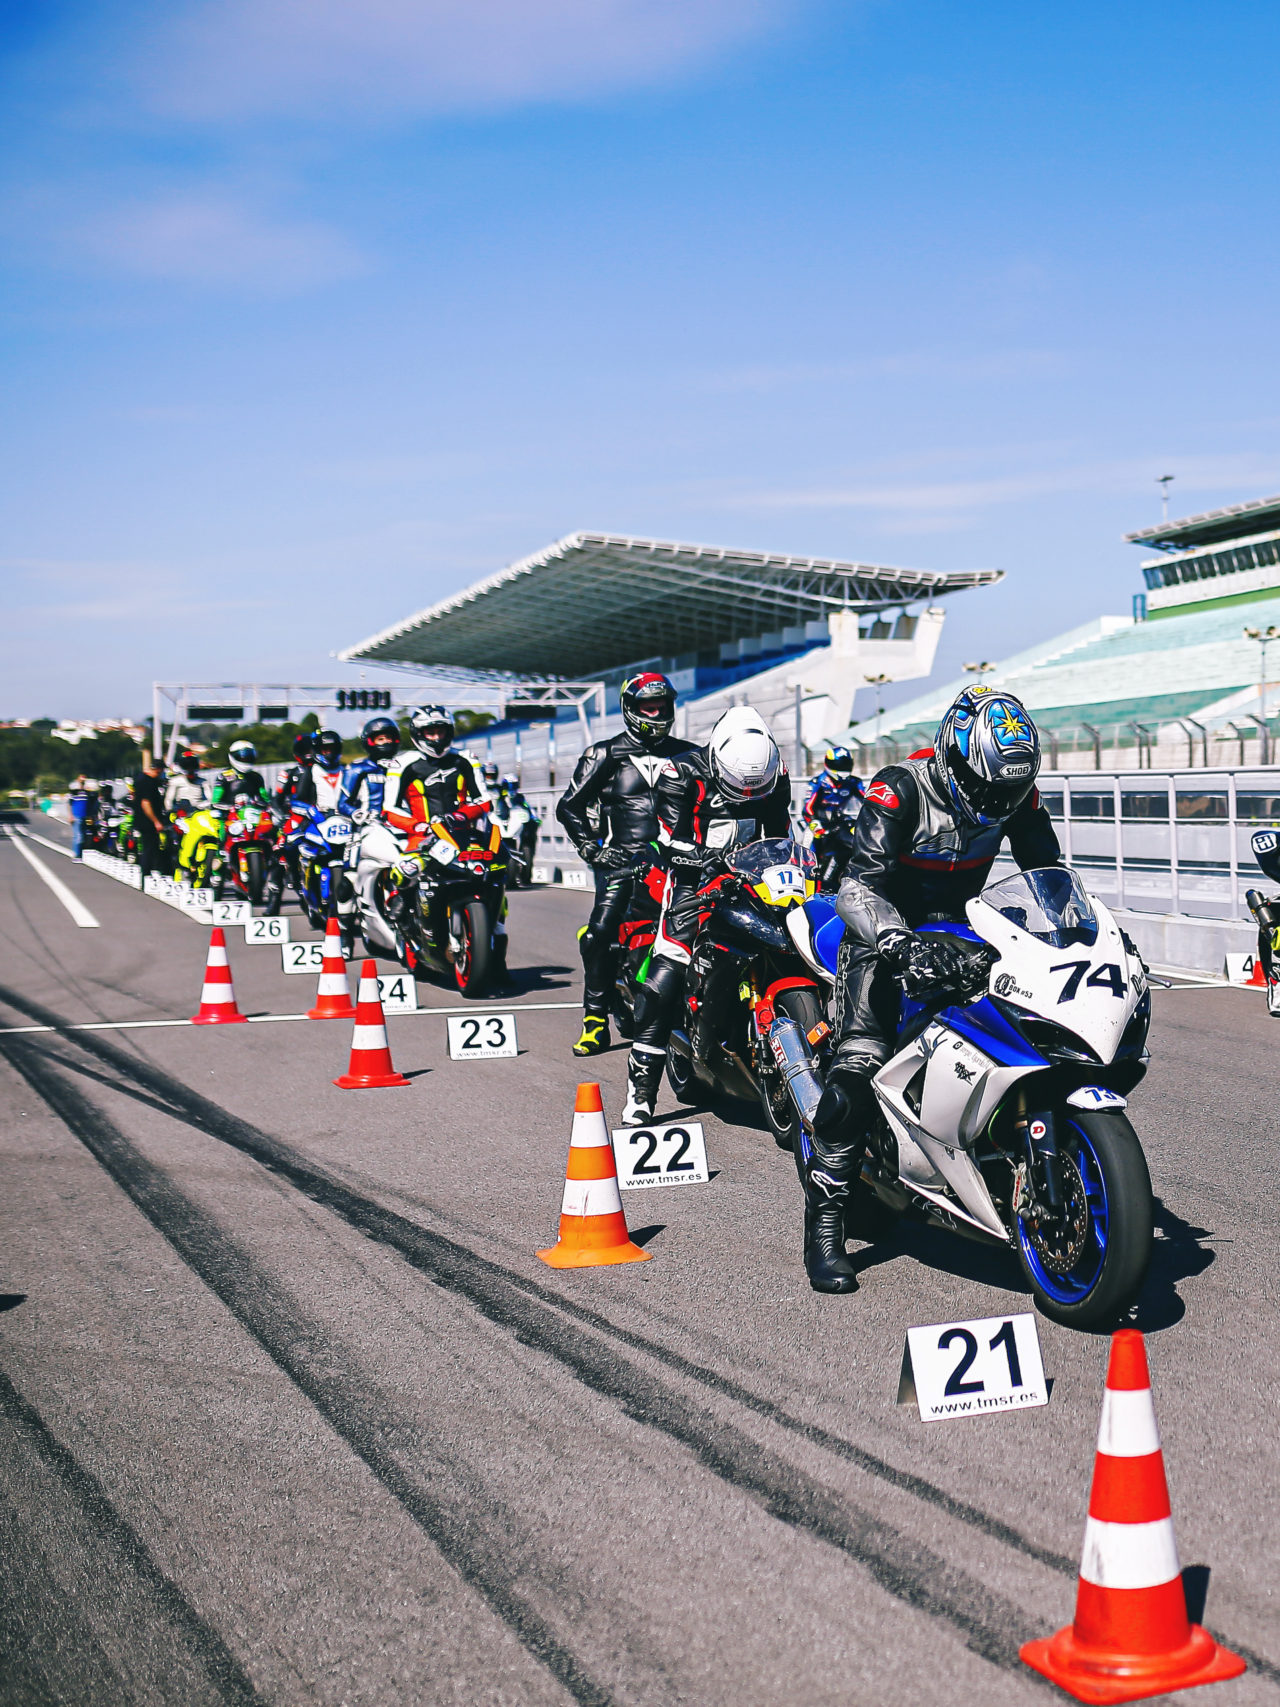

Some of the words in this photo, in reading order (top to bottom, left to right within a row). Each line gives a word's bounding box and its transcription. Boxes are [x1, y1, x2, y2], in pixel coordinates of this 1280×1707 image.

[776, 870, 793, 885] 17
[187, 892, 208, 905] 28
[221, 904, 244, 920] 27
[253, 919, 282, 937] 26
[291, 944, 324, 966] 25
[1242, 955, 1254, 973] 4
[1049, 959, 1129, 1005] 74
[460, 1017, 507, 1050] 23
[629, 1127, 695, 1176] 22
[626, 1172, 702, 1187] www.tmsr.es
[937, 1320, 1024, 1398] 21
[930, 1391, 1038, 1414] www.tmsr.es
